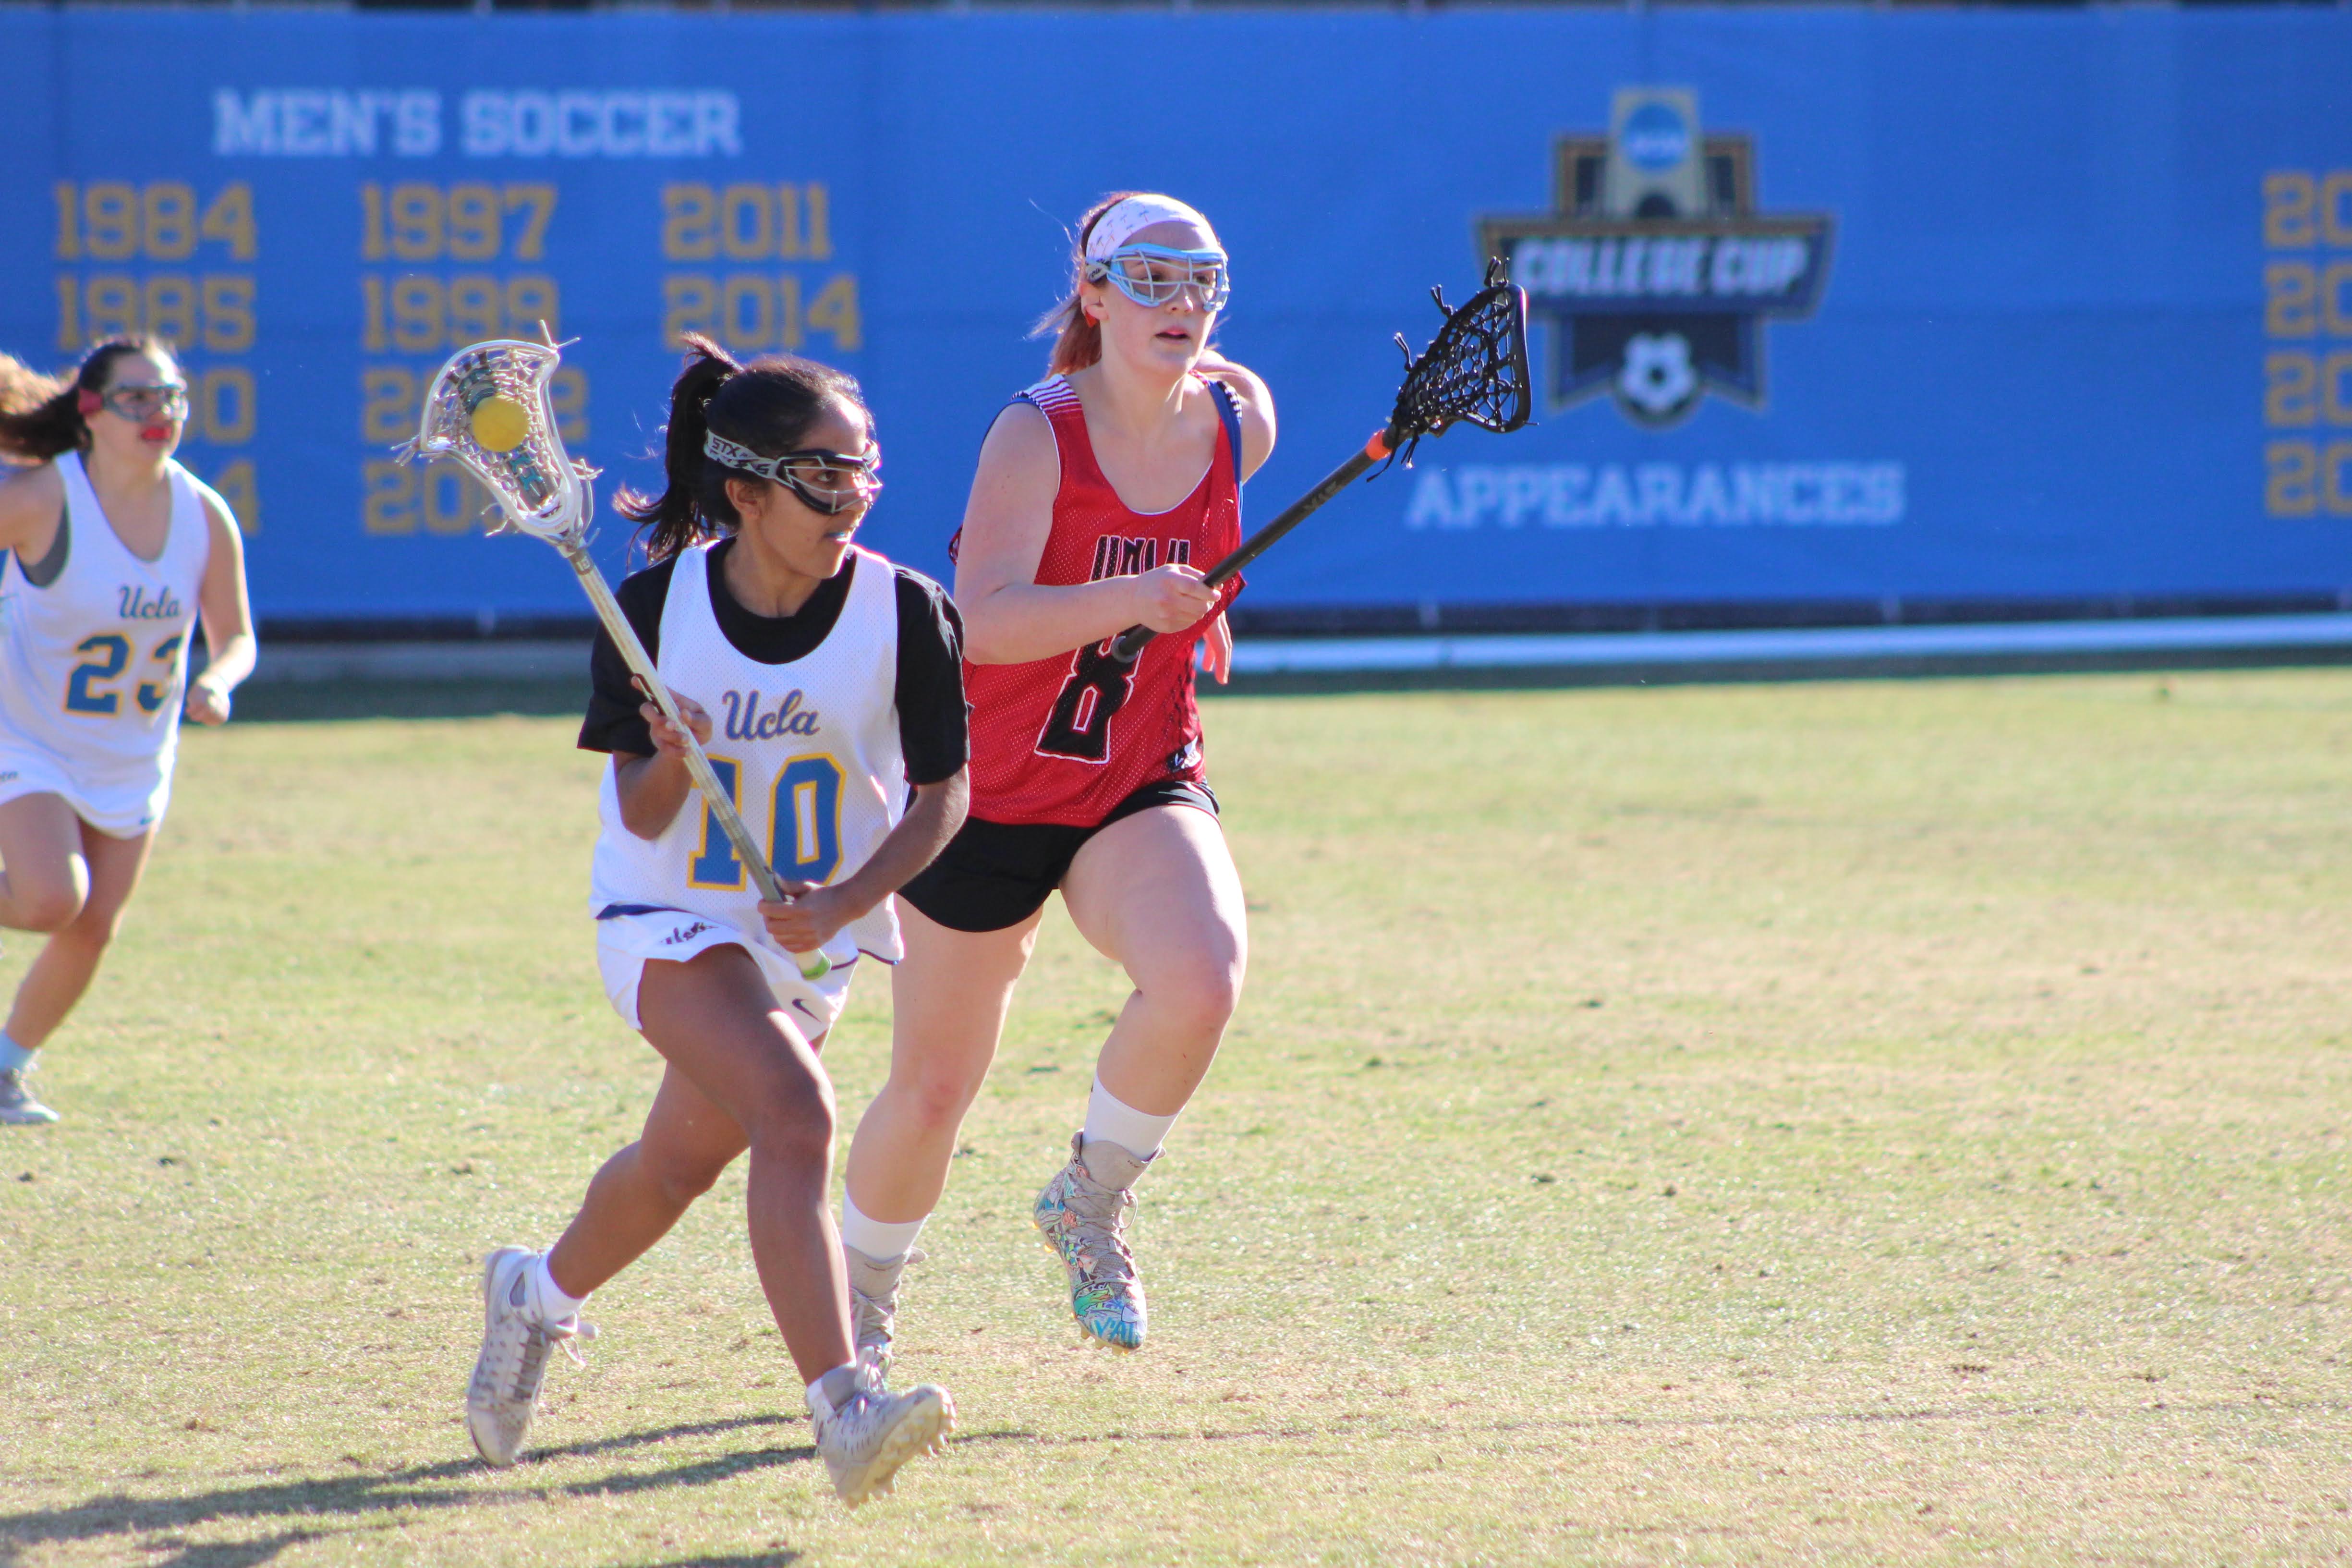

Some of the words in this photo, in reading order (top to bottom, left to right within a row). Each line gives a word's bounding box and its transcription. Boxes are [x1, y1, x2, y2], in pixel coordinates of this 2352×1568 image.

[213, 89, 442, 157] MEN'S
[462, 89, 742, 157] SOCCER
[54, 180, 258, 261] 1984
[360, 180, 558, 261] 1997
[662, 180, 833, 261] 2011
[1512, 235, 1710, 298] COLLEGE
[1710, 235, 1809, 297] CUP
[54, 274, 258, 352] 1985
[360, 274, 560, 352] 1999
[662, 274, 862, 352] 2014
[712, 437, 741, 457] STX
[1405, 463, 1906, 528] APPEARANCES
[1033, 626, 1146, 765] 8
[687, 752, 847, 892] 10
